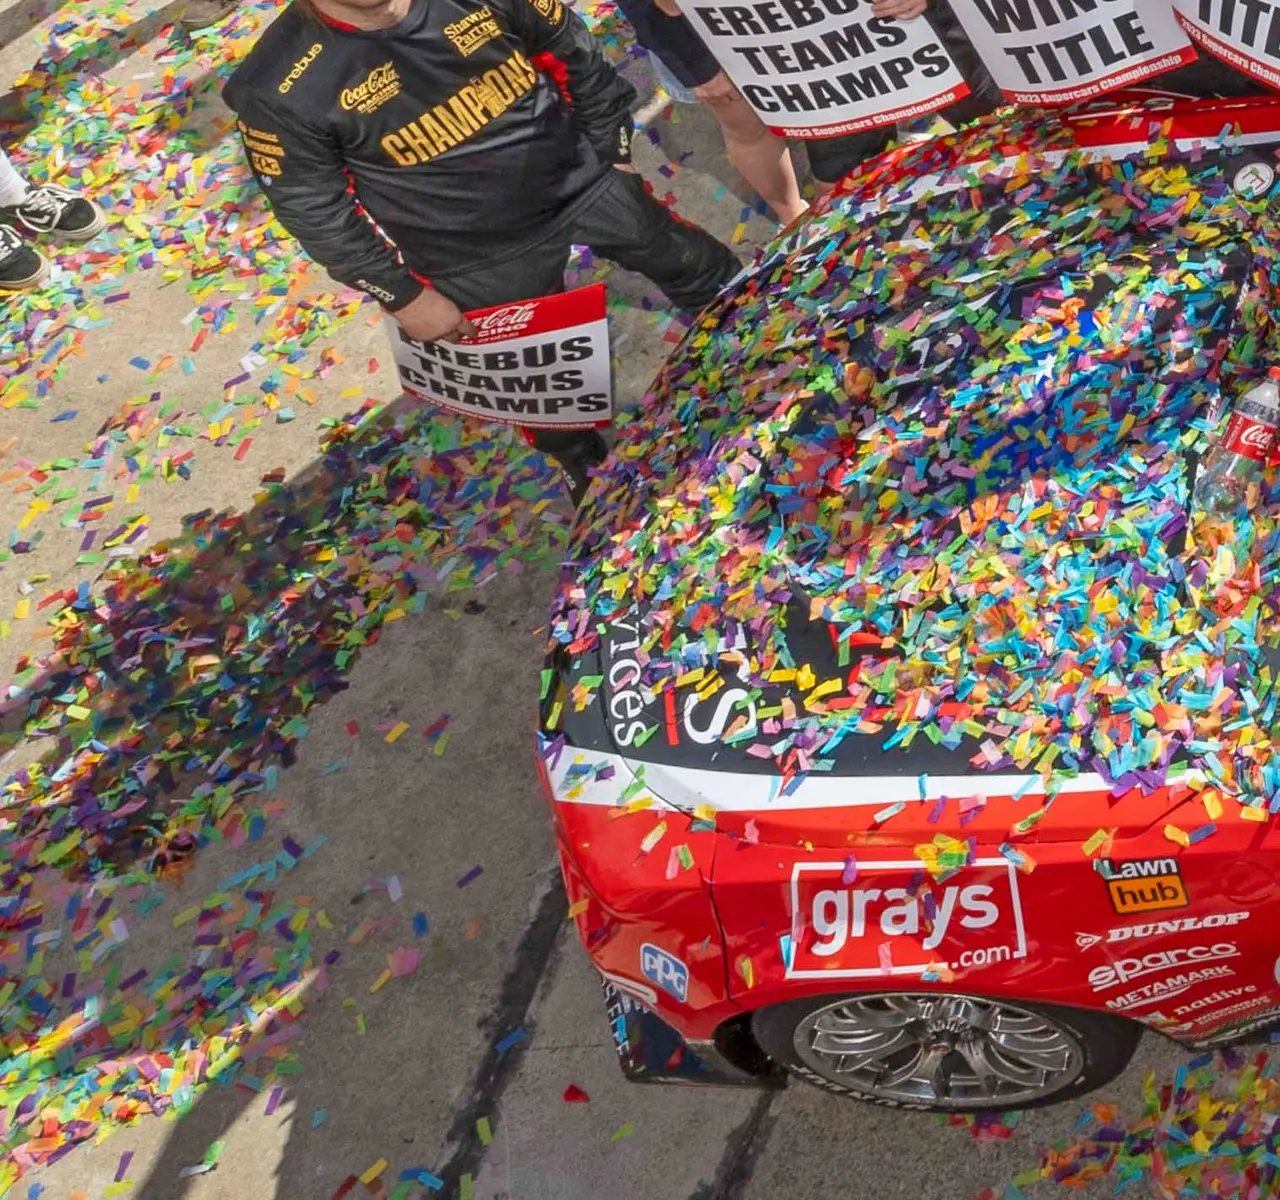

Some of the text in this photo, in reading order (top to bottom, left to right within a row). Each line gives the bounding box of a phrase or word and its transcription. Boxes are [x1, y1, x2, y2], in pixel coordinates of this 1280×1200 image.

[278, 43, 323, 94] erebus
[731, 16, 908, 76] TEAMS
[1003, 11, 1154, 85] TITLE
[340, 60, 399, 111] Coca-Cola
[741, 42, 951, 113] CHAMPS
[1041, 53, 1182, 103] Supercars Championship
[812, 92, 956, 137] Supercars Championship
[399, 365, 609, 415] CHAMPS
[412, 352, 584, 393] TEAMS
[1102, 858, 1178, 880] Lawn
[1116, 883, 1179, 906] hub
[809, 880, 1000, 960] grays
[1106, 912, 1250, 943] DUNLOP
[641, 947, 688, 995] PPG
[948, 941, 1012, 970] .com
[1088, 942, 1238, 987] sparco
[1105, 965, 1234, 1009] METAMARK
